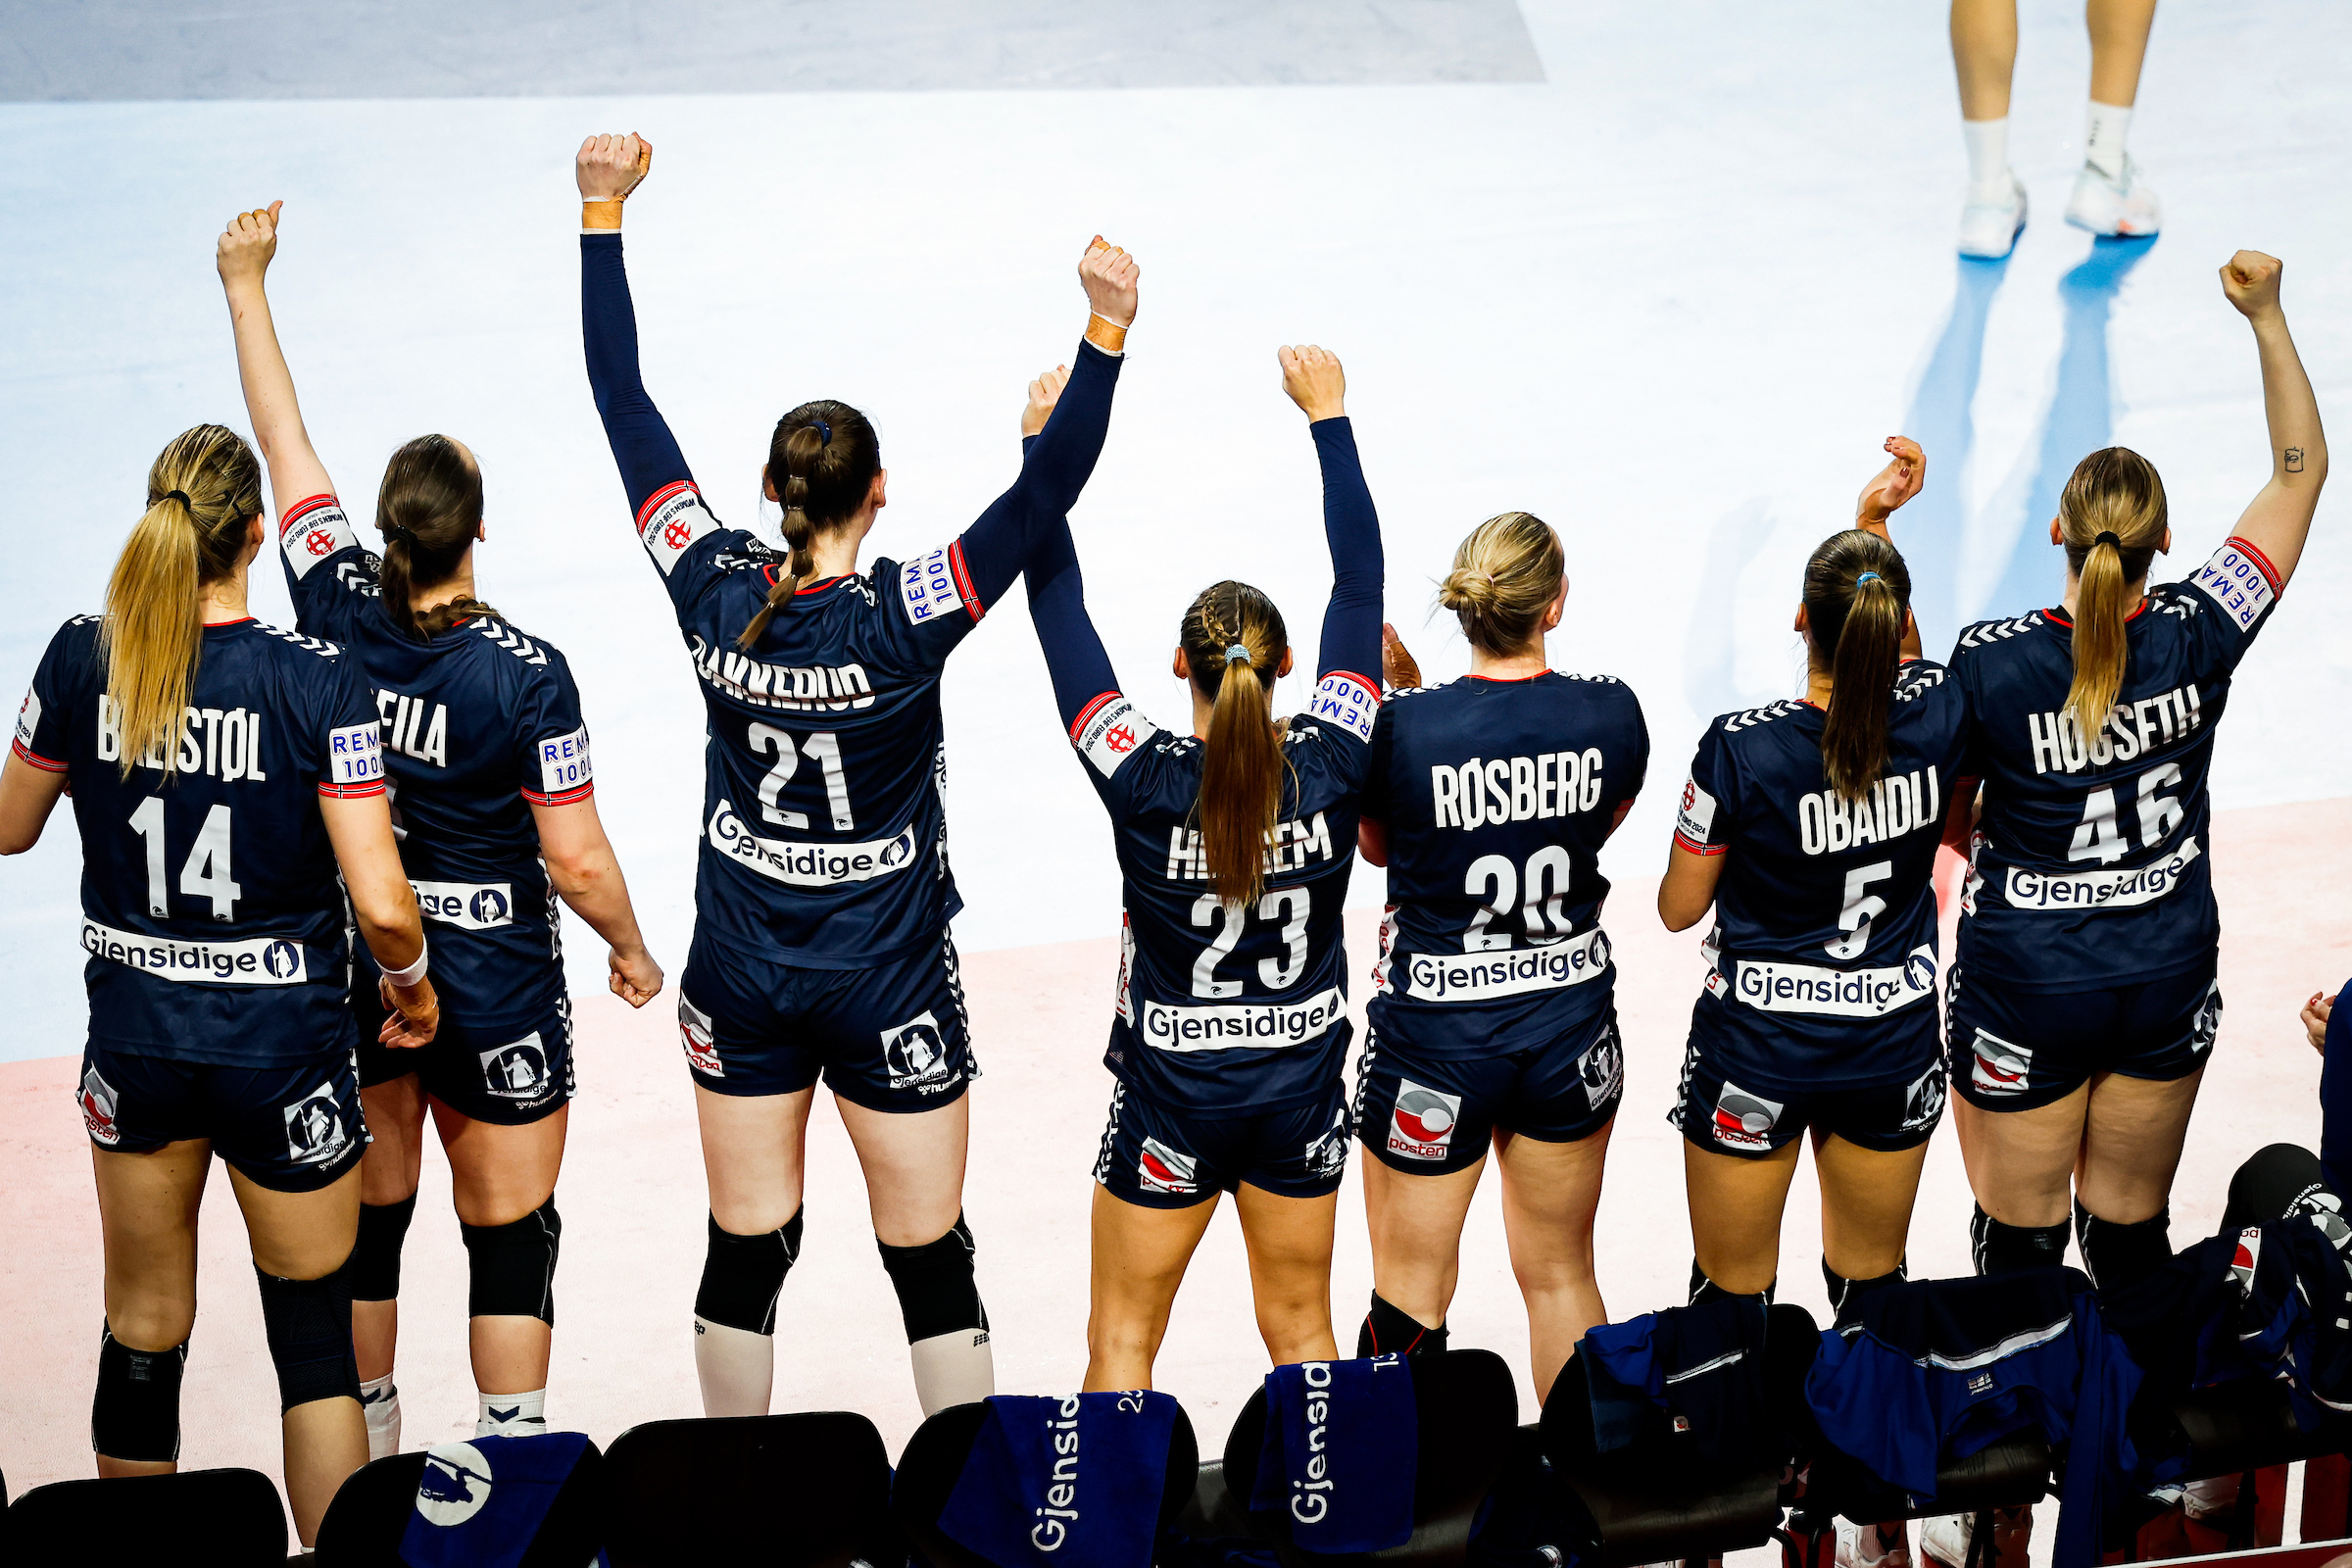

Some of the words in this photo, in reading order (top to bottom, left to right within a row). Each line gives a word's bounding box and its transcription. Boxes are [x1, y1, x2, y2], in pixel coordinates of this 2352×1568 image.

[906, 558, 933, 619] REM
[2201, 565, 2255, 625] REMA
[2223, 554, 2266, 601] 1000
[372, 688, 448, 768] EILA
[1321, 679, 1372, 712] 1000
[2028, 683, 2202, 775] HØGSETH
[97, 693, 267, 783] BSTØL
[332, 728, 381, 754] REM
[747, 721, 855, 831] 21
[1431, 747, 1604, 832] RØSBERG
[1798, 764, 1940, 857] OBAIDLI
[2068, 761, 2185, 866] 46
[127, 796, 242, 923] 14
[1166, 811, 1334, 880] HEEM
[2012, 857, 2184, 906] Gjensidige
[1463, 845, 1572, 953] 20
[1823, 859, 1893, 959] 5
[1191, 885, 1312, 999] 23
[1412, 947, 1588, 997] Gjensidige
[1149, 1007, 1325, 1048] Gjensidige
[84, 1114, 119, 1142] osten
[1389, 1138, 1446, 1156] posten
[1031, 1393, 1081, 1552] Gjensid
